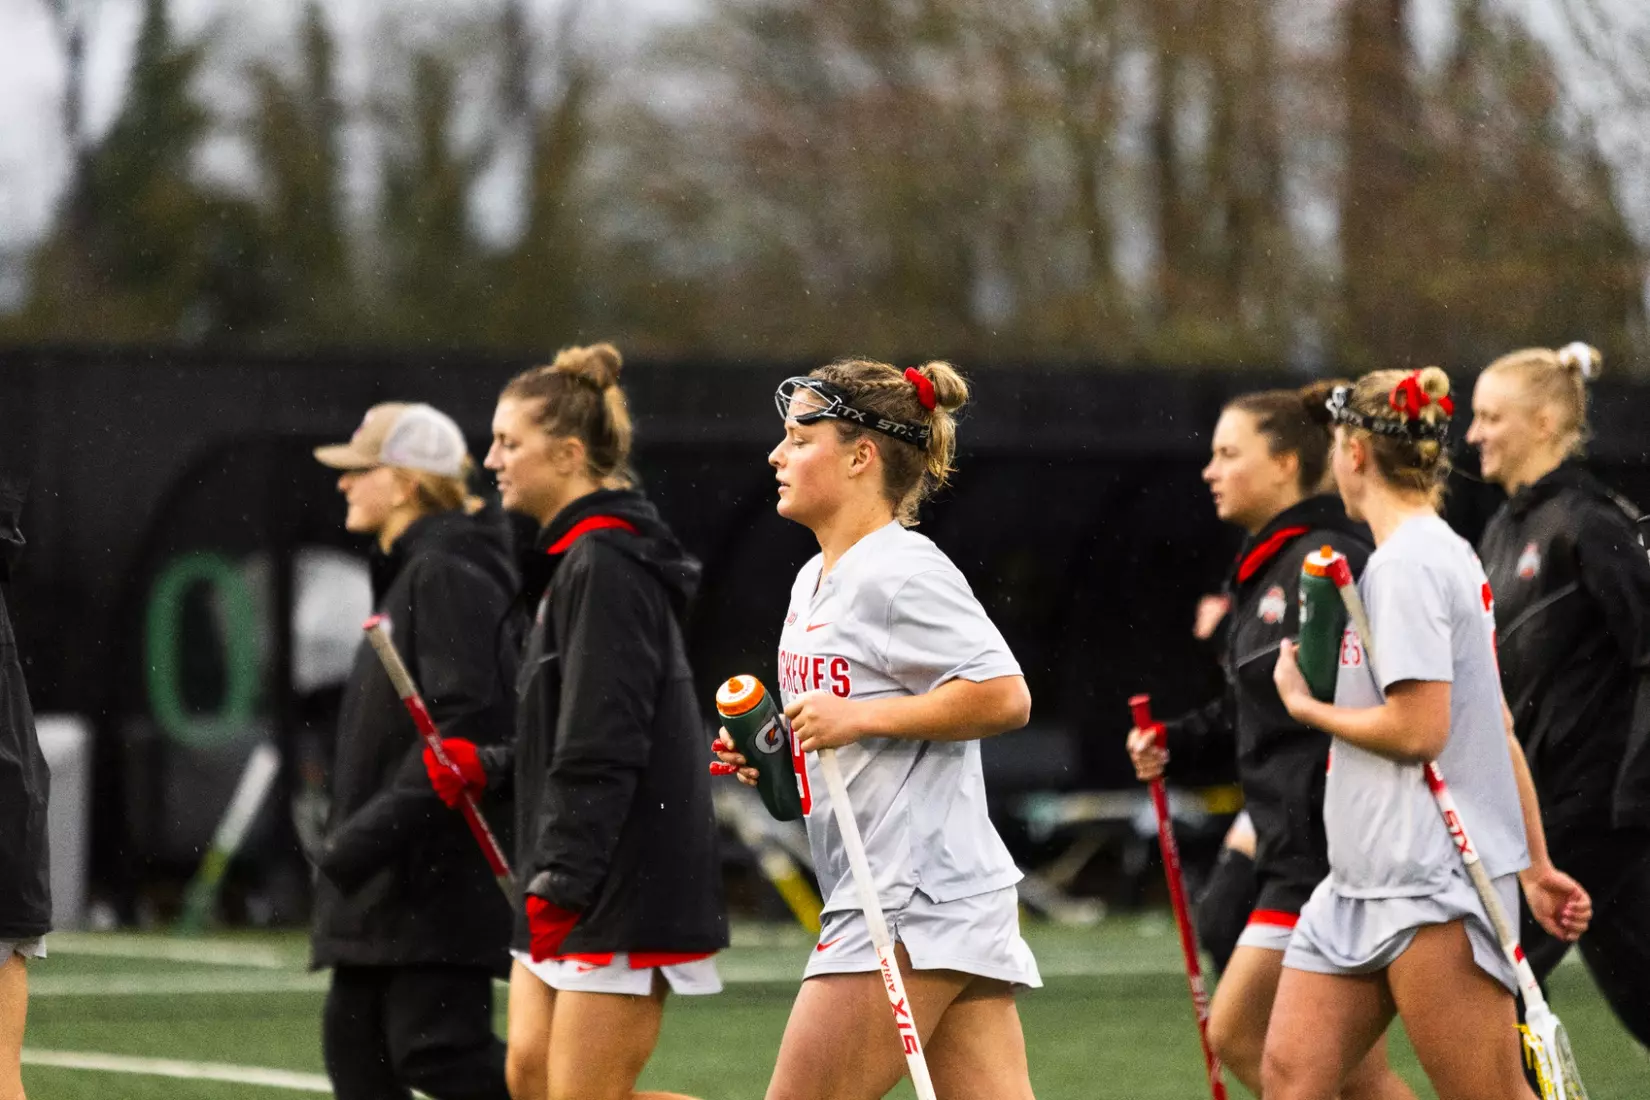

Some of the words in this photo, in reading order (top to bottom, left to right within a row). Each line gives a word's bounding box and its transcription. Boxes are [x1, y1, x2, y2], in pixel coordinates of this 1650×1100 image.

[876, 418, 913, 438] STX
[1443, 809, 1473, 855] STX
[881, 957, 897, 993] ARIA
[889, 997, 919, 1055] STX
